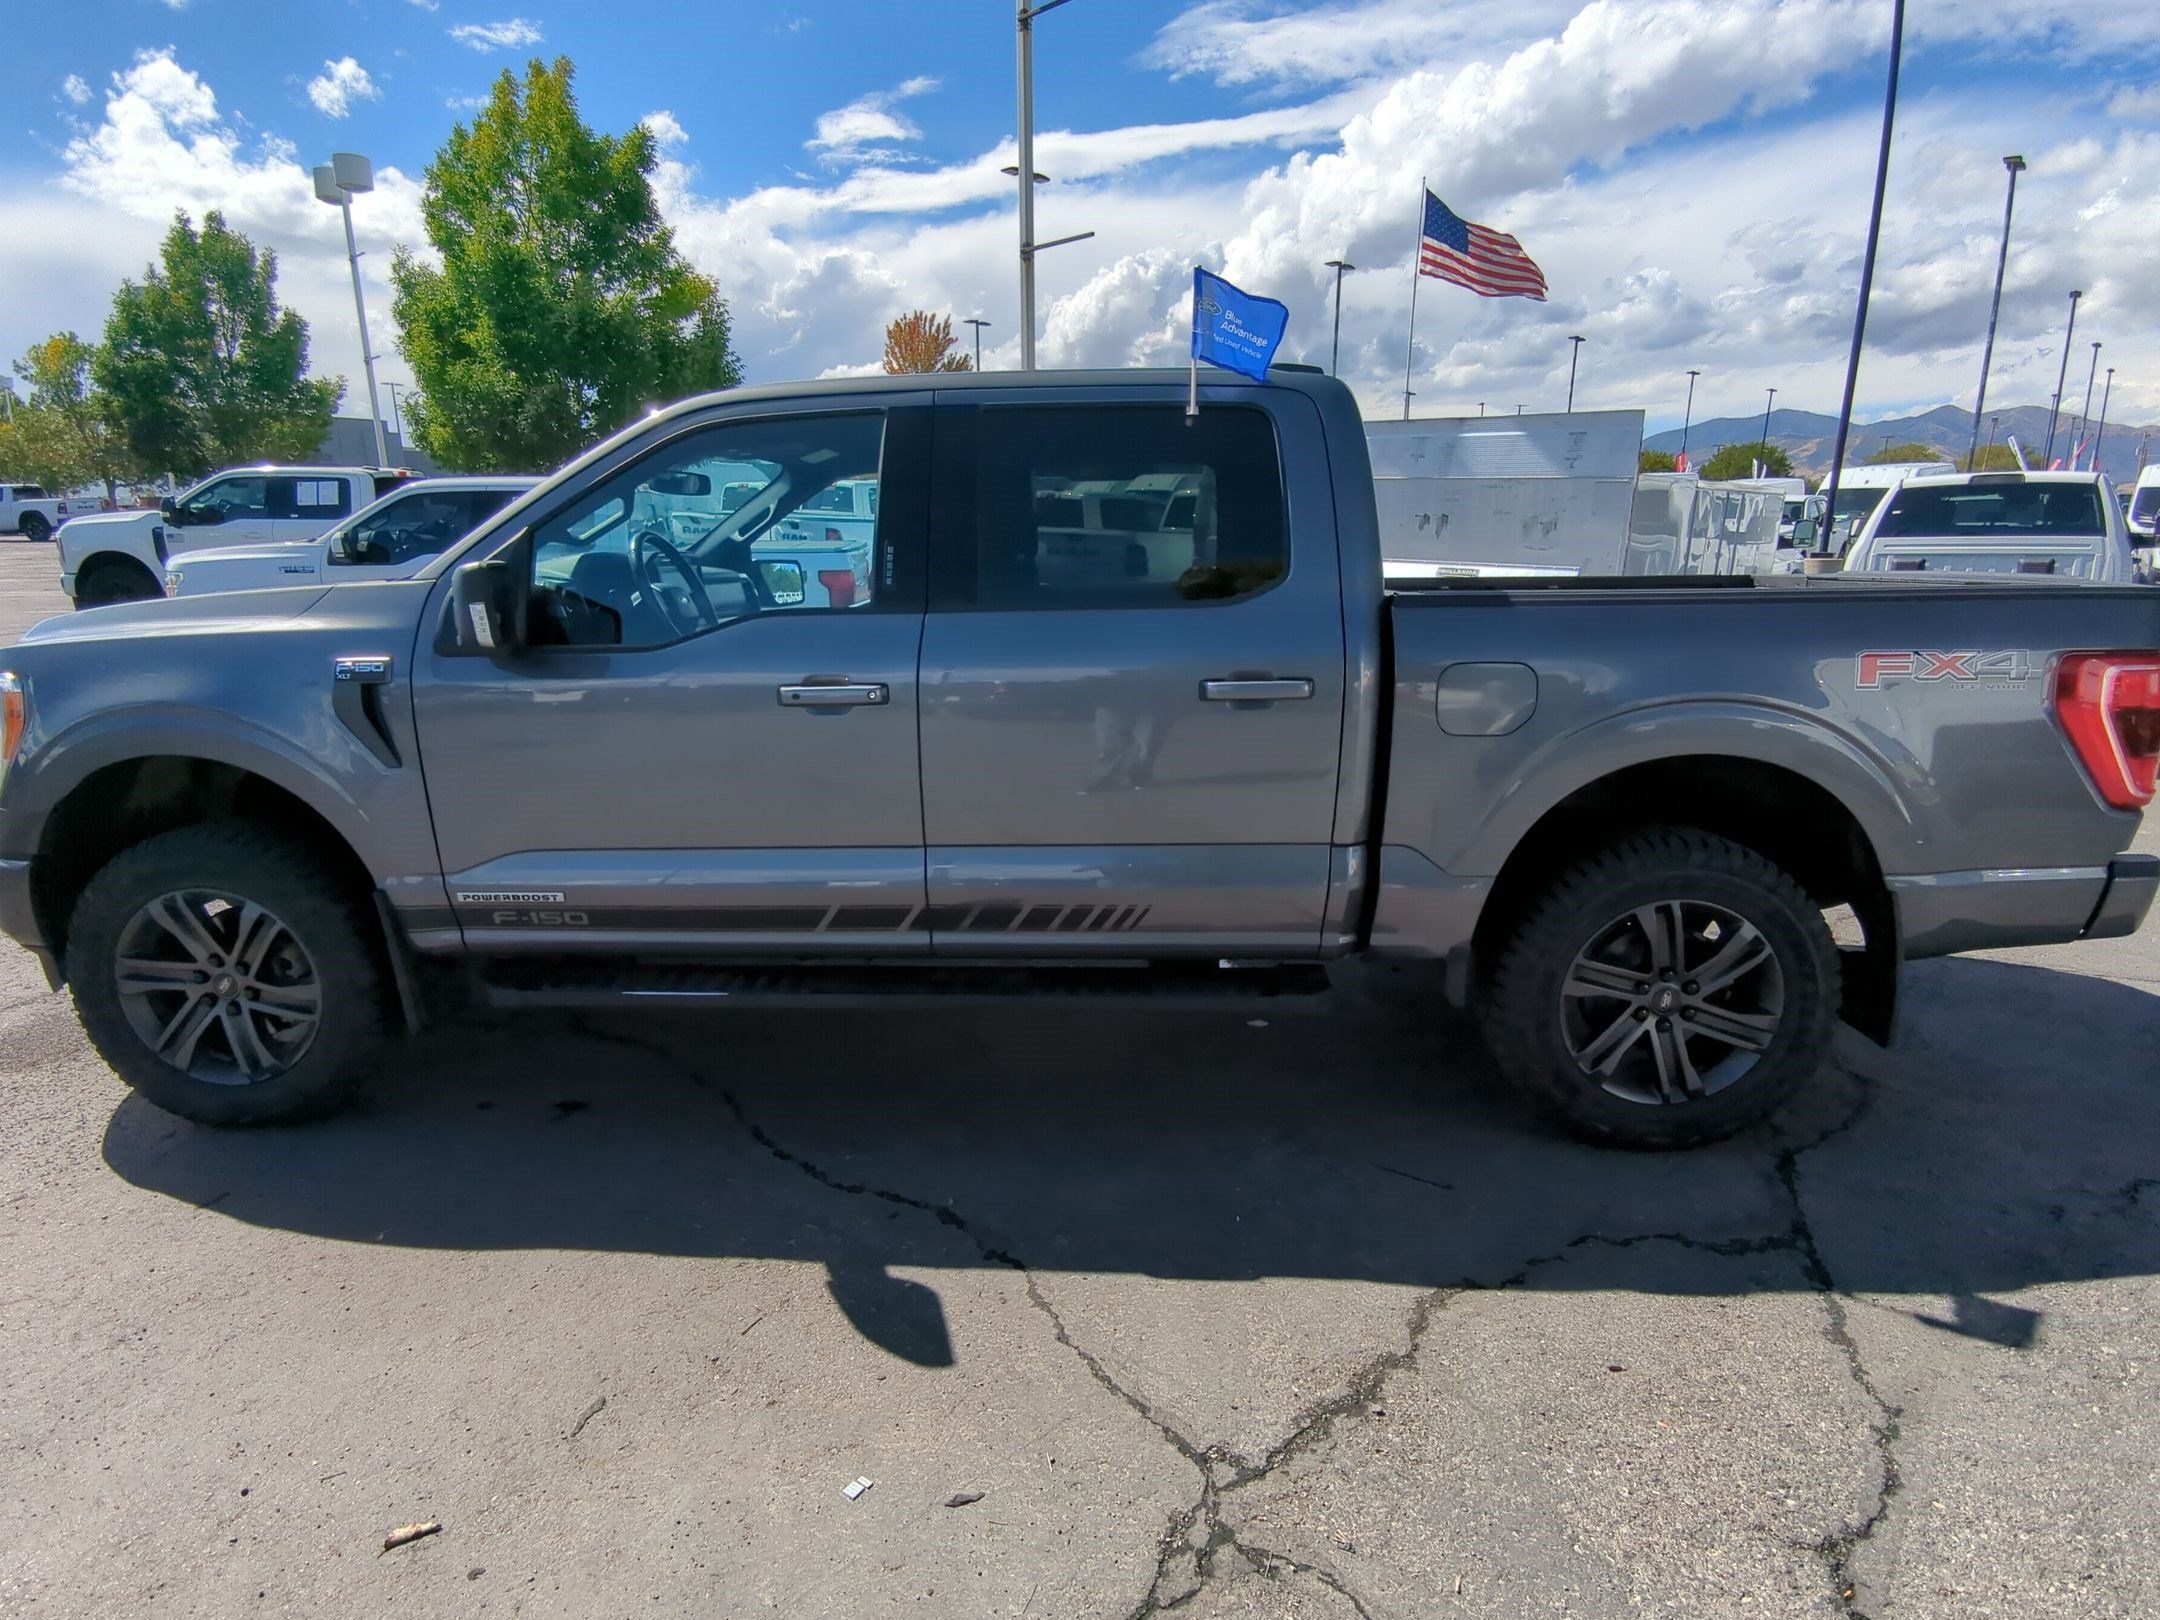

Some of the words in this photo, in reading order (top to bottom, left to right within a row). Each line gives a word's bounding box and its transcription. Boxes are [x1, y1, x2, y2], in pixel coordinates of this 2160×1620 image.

[1224, 310, 1242, 325] Blue
[1221, 321, 1267, 347] Advantage
[1224, 338, 1241, 350] Used
[1241, 345, 1262, 359] Vehicle
[1855, 649, 2030, 691] FX4
[462, 893, 559, 902] POWERBOOST
[492, 911, 590, 926] F-150
